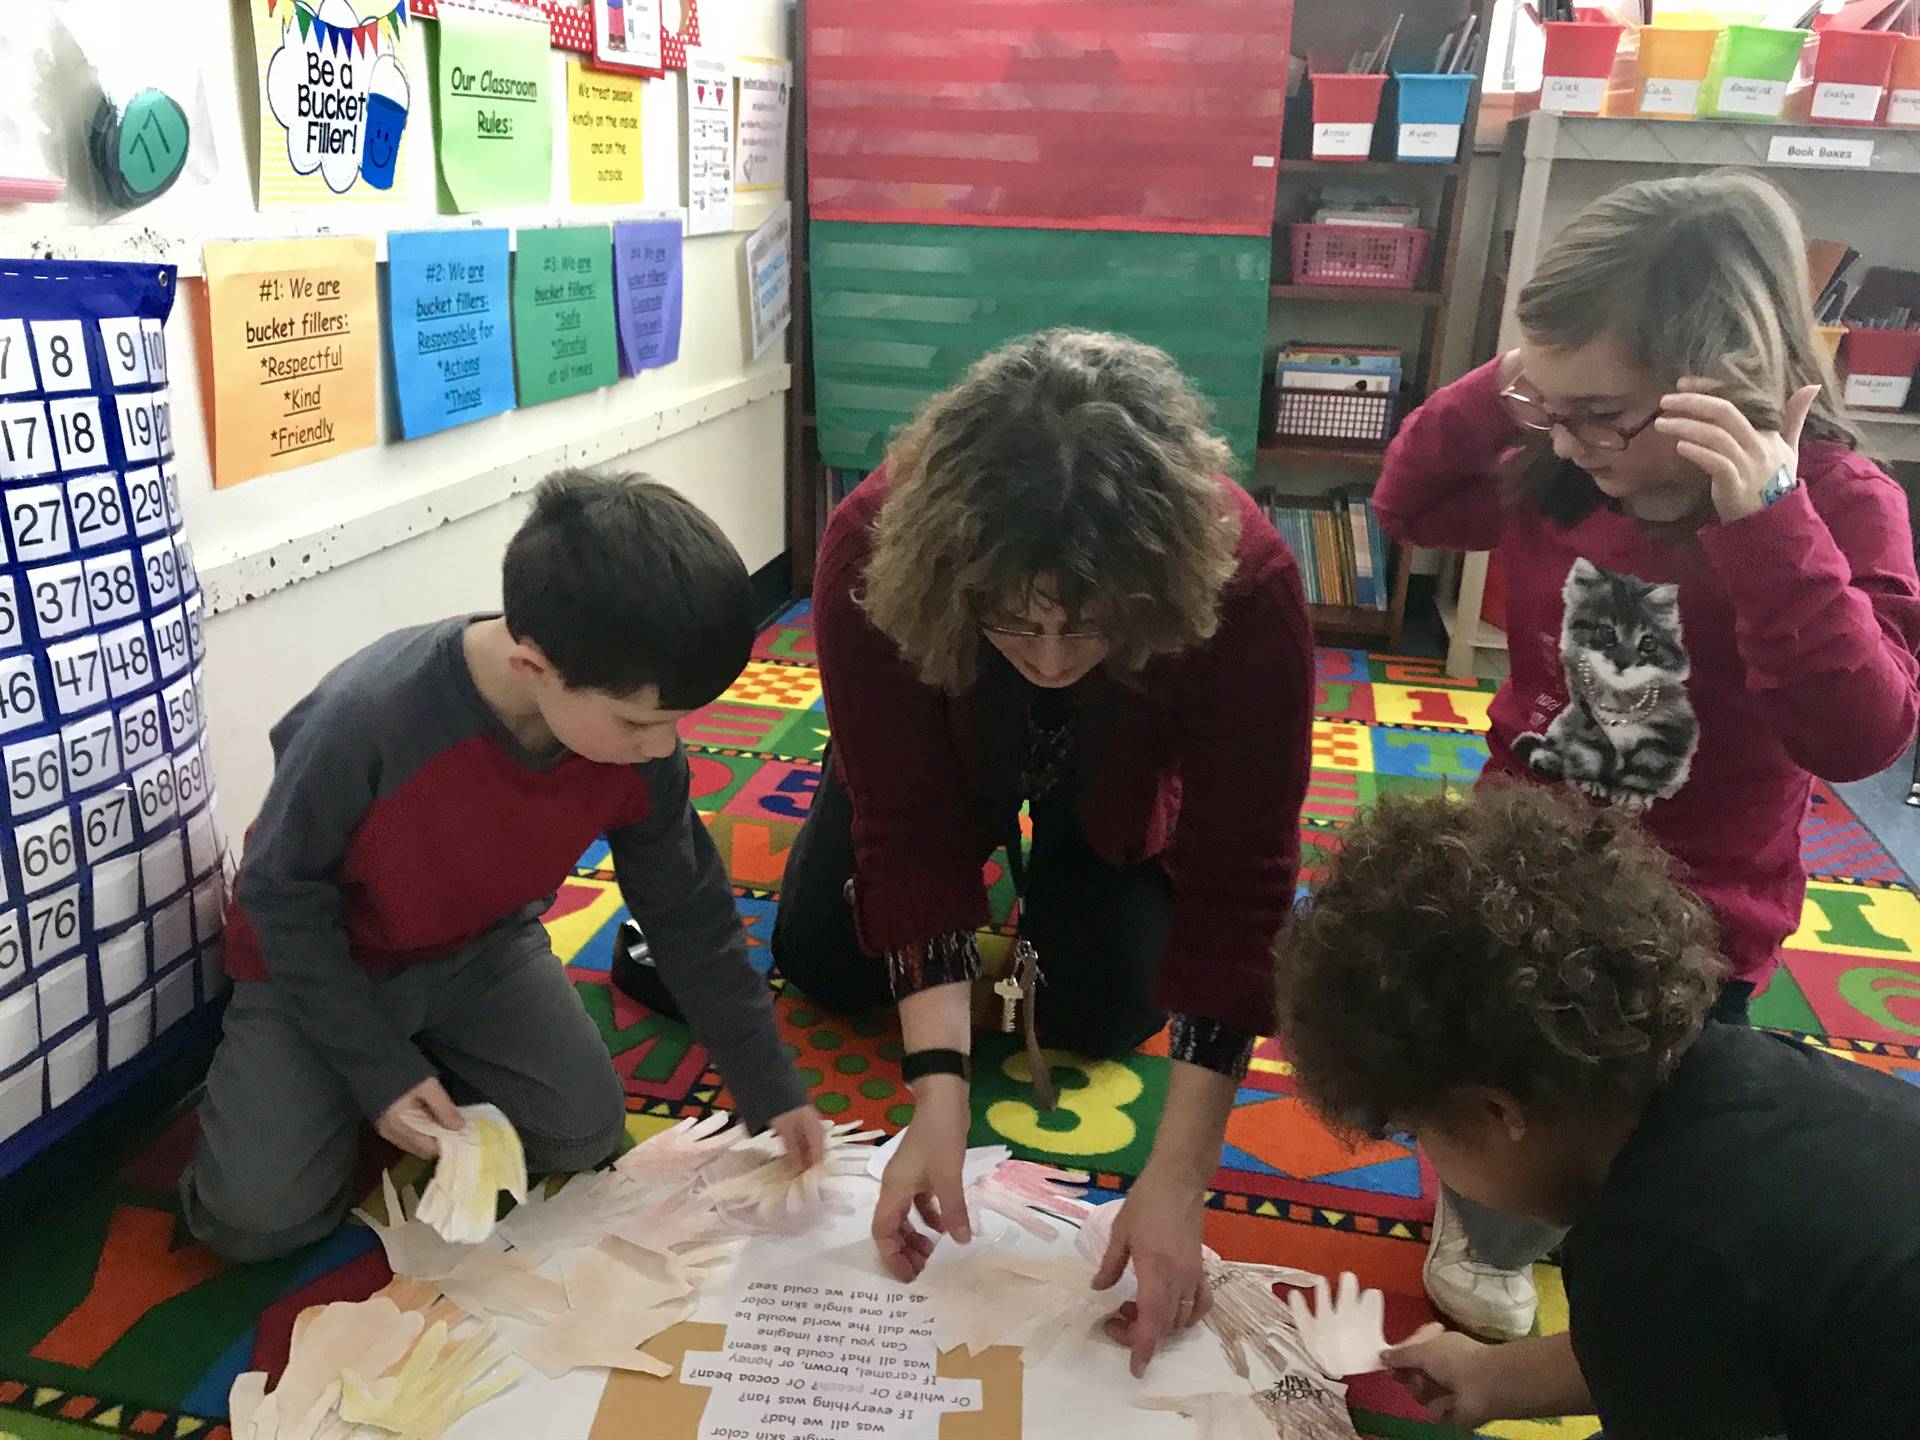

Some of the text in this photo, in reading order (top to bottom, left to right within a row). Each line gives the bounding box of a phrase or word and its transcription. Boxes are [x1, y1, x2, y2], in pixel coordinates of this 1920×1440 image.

[306, 51, 353, 89] Be a
[450, 66, 538, 98] Our Classroom
[297, 83, 366, 122] Bucket
[578, 82, 634, 106] We treat people
[477, 109, 514, 135] Rules:
[572, 110, 638, 130] kindly on the inside
[306, 120, 358, 155] Filler!
[591, 142, 627, 156] and on the
[1787, 145, 1853, 159] Book Boxes
[597, 167, 623, 182] outside
[425, 262, 485, 283] #2: We are
[561, 255, 576, 272] We
[577, 257, 592, 270] are
[259, 277, 341, 302] #1: We are
[533, 281, 596, 303] bucket fillers:
[415, 291, 489, 318] bucket fillers:
[245, 311, 350, 344] bucket fillers:
[417, 320, 496, 351] Responsible for
[50, 334, 74, 378] 8
[116, 331, 137, 372] 9
[147, 330, 164, 371] 10
[570, 362, 594, 378] times
[1, 416, 37, 463] 17
[60, 411, 95, 455] 18
[126, 406, 151, 447] 19
[14, 499, 62, 548] 27
[74, 485, 122, 534] 28
[131, 478, 163, 524] 29
[36, 575, 82, 625] 37
[90, 564, 136, 612] 38
[147, 549, 176, 595] 39
[54, 650, 98, 697] 47
[106, 635, 149, 681] 48
[156, 619, 186, 662] 49
[11, 687, 195, 800] 56 57 58 59
[23, 755, 202, 877] 66 67 68 69
[32, 898, 76, 951] 76
[986, 1048, 1144, 1156] 3
[747, 1282, 778, 1291] see?
[783, 1284, 819, 1295] could
[825, 1288, 844, 1297] we
[849, 1291, 878, 1302] that
[740, 1296, 776, 1306] color
[781, 1300, 808, 1310] skin
[813, 1301, 853, 1314] single
[886, 1293, 903, 1303] all
[734, 1310, 751, 1320] be
[757, 1313, 797, 1324] would
[802, 1317, 841, 1328] world
[859, 1307, 883, 1317] one
[848, 1322, 870, 1332] the
[878, 1325, 904, 1336] dull
[757, 1328, 907, 1352] Can you just imagine
[727, 1341, 930, 1370] was all that could be seen?
[728, 1353, 936, 1386] If caramel, brown, or honey
[689, 1368, 970, 1407] Or white? Or peach? Or cocoa bean?
[738, 1392, 914, 1420] If everything was tan?
[710, 1427, 749, 1439] color
[760, 1414, 884, 1433] was all we had?
[756, 1432, 786, 1440] skin
